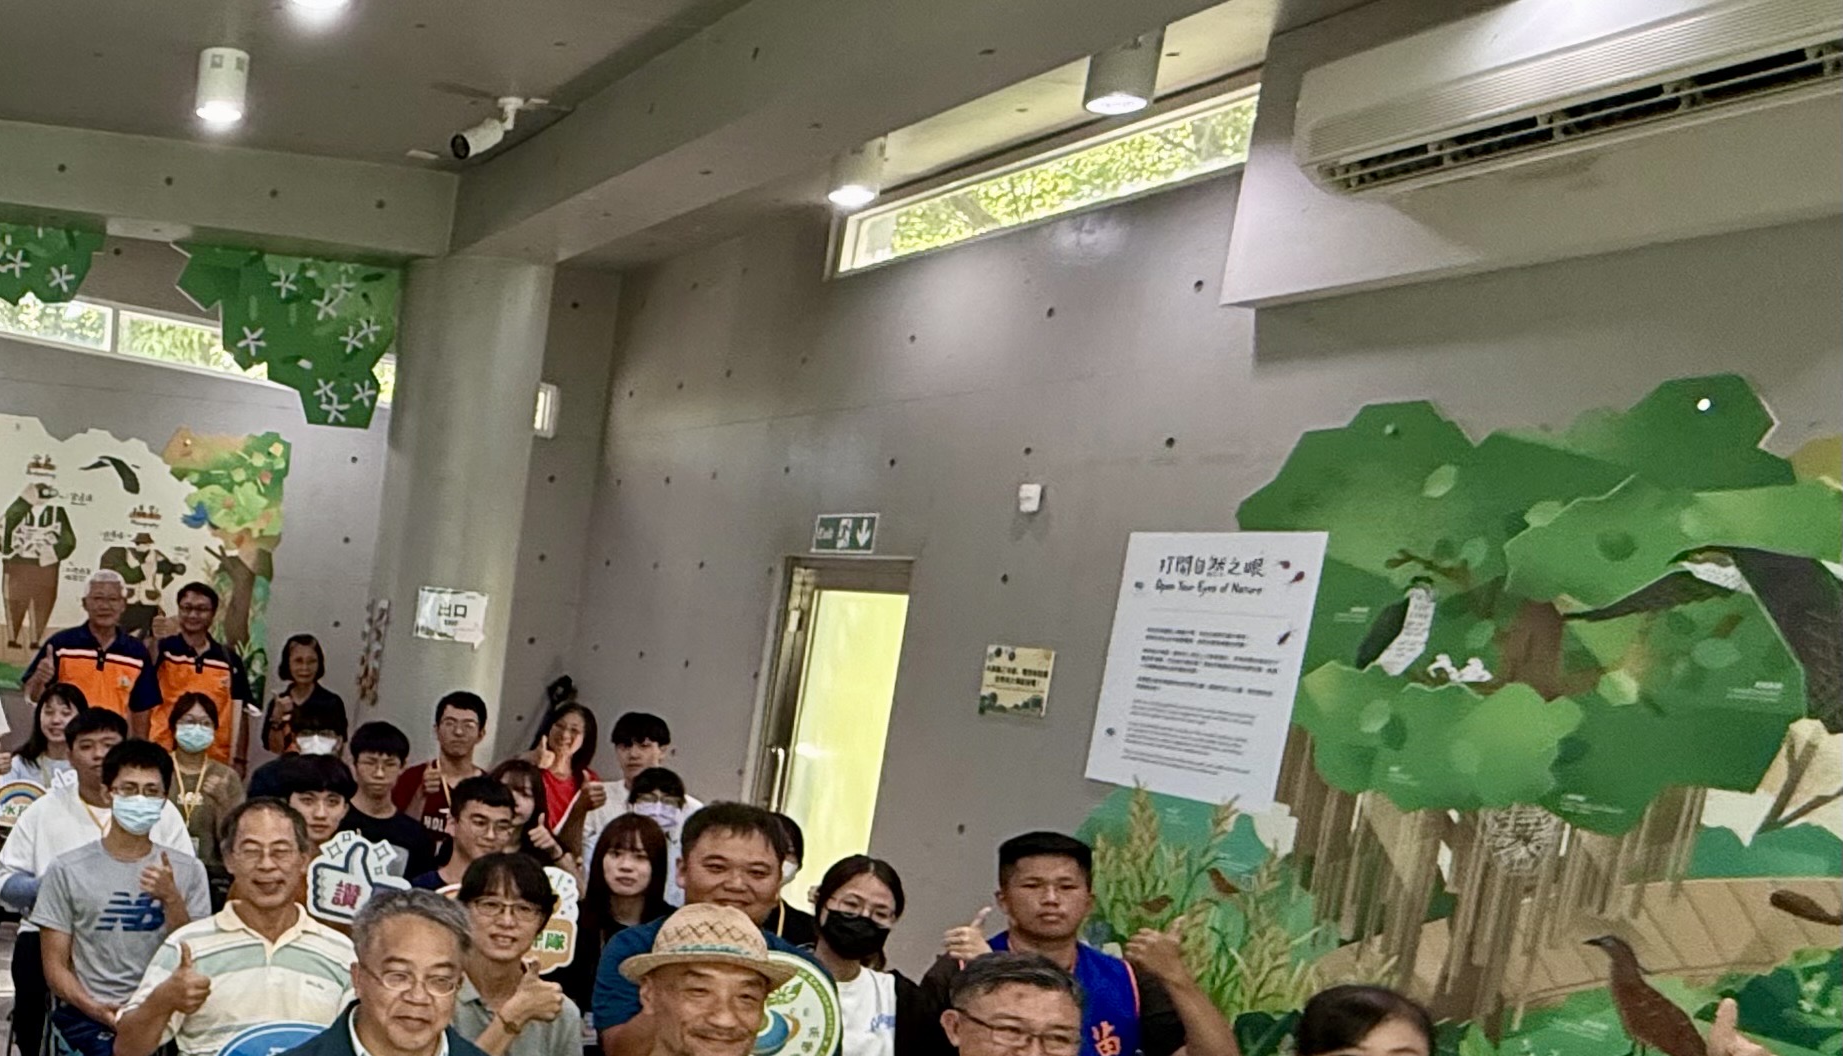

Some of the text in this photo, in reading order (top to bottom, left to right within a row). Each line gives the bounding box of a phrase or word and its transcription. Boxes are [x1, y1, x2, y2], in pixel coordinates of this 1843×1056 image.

[1159, 555, 1264, 577] 打開自然之眼
[1156, 578, 1175, 593] Open
[1197, 580, 1216, 597] Eyes
[1231, 583, 1263, 595] Nature
